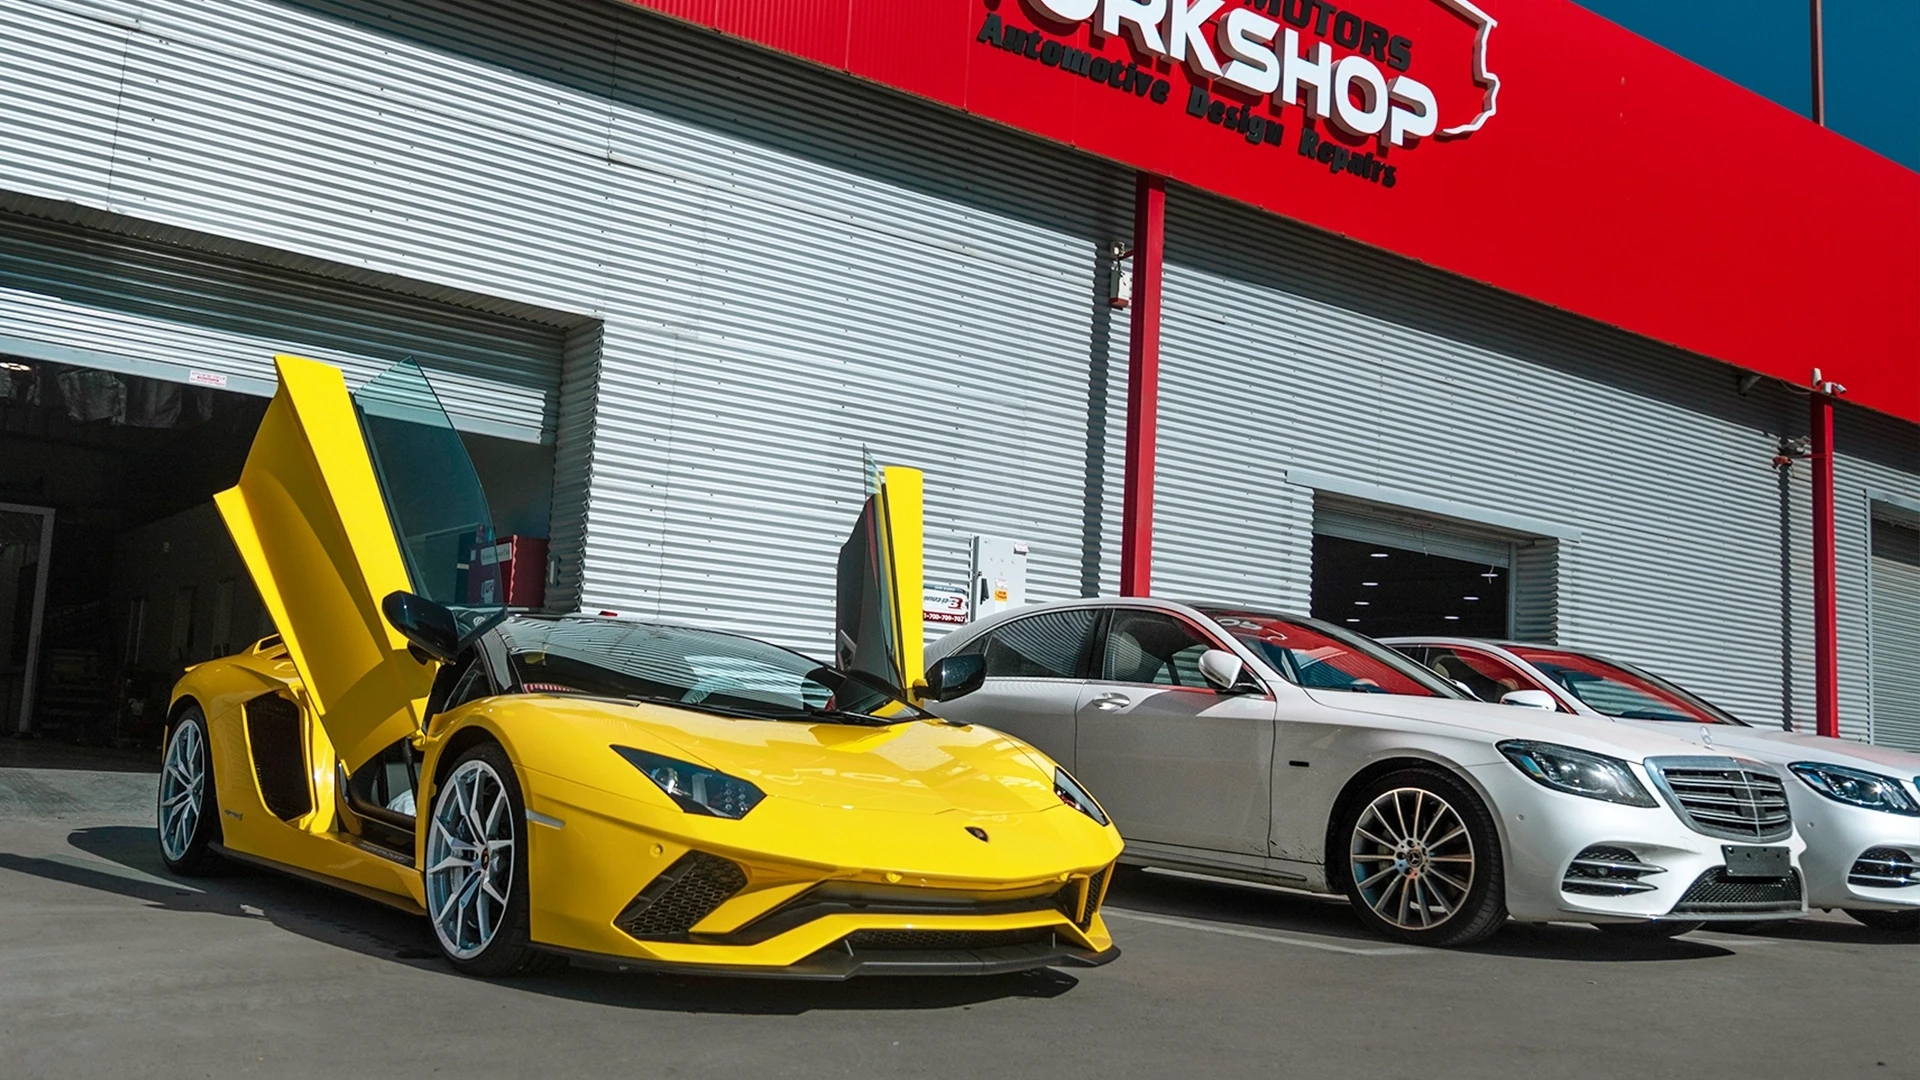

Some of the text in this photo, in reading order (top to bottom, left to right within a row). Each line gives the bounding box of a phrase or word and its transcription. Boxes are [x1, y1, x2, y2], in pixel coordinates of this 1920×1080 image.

[977, 12, 1397, 188] Automotive Design Repairs
[1033, 0, 1439, 147] RKSHOP
